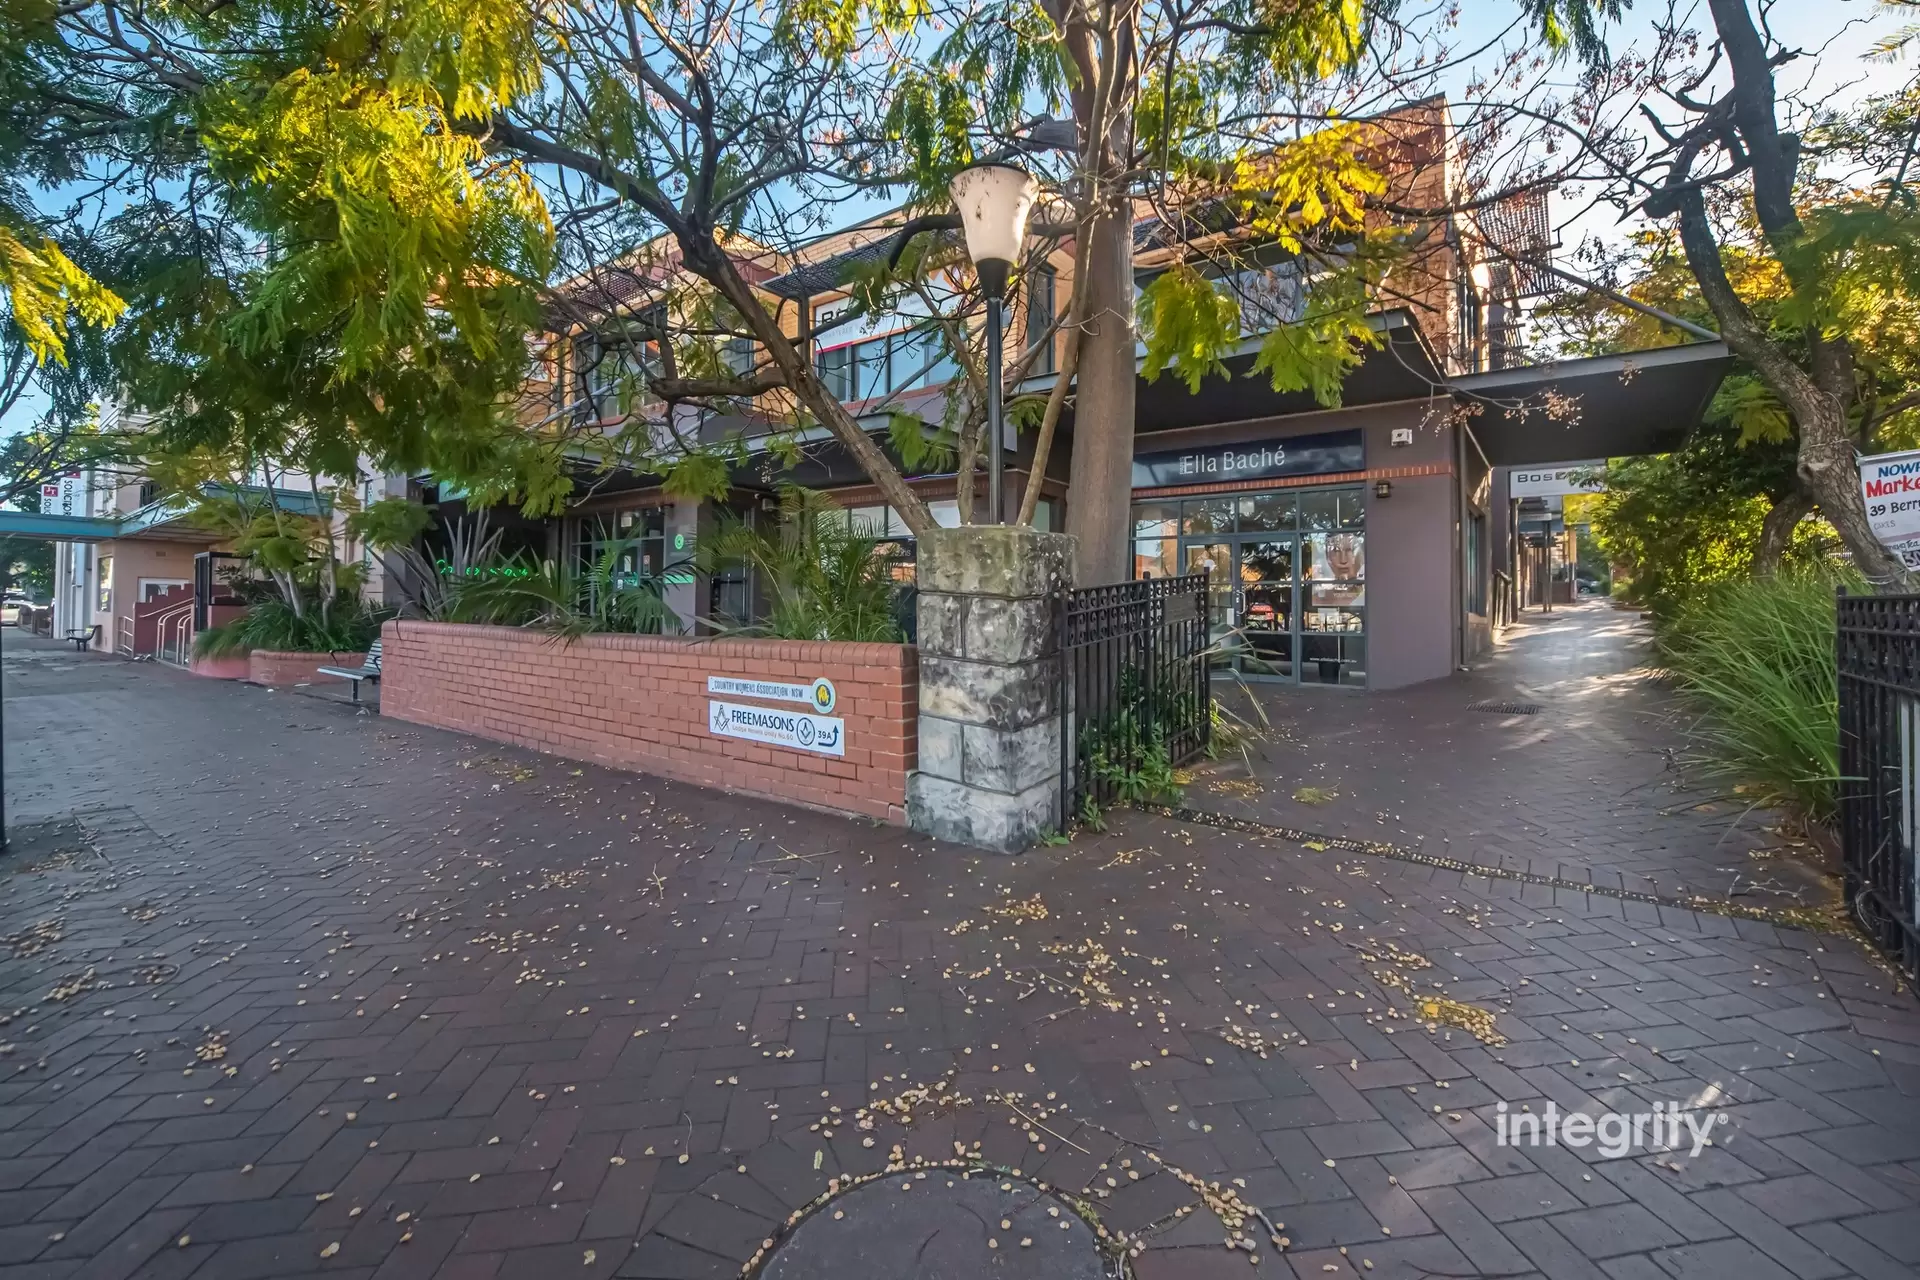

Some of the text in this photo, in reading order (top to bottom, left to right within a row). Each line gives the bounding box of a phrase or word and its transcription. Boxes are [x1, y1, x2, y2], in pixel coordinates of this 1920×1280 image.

[1184, 454, 1217, 474] Ella
[1223, 444, 1285, 471] Baché
[1870, 504, 1887, 517] 39
[714, 680, 804, 698] COUNTRY WOMENS ASSOCIATION NSW
[731, 709, 795, 733] FREEMASONS
[817, 731, 832, 740] 39A
